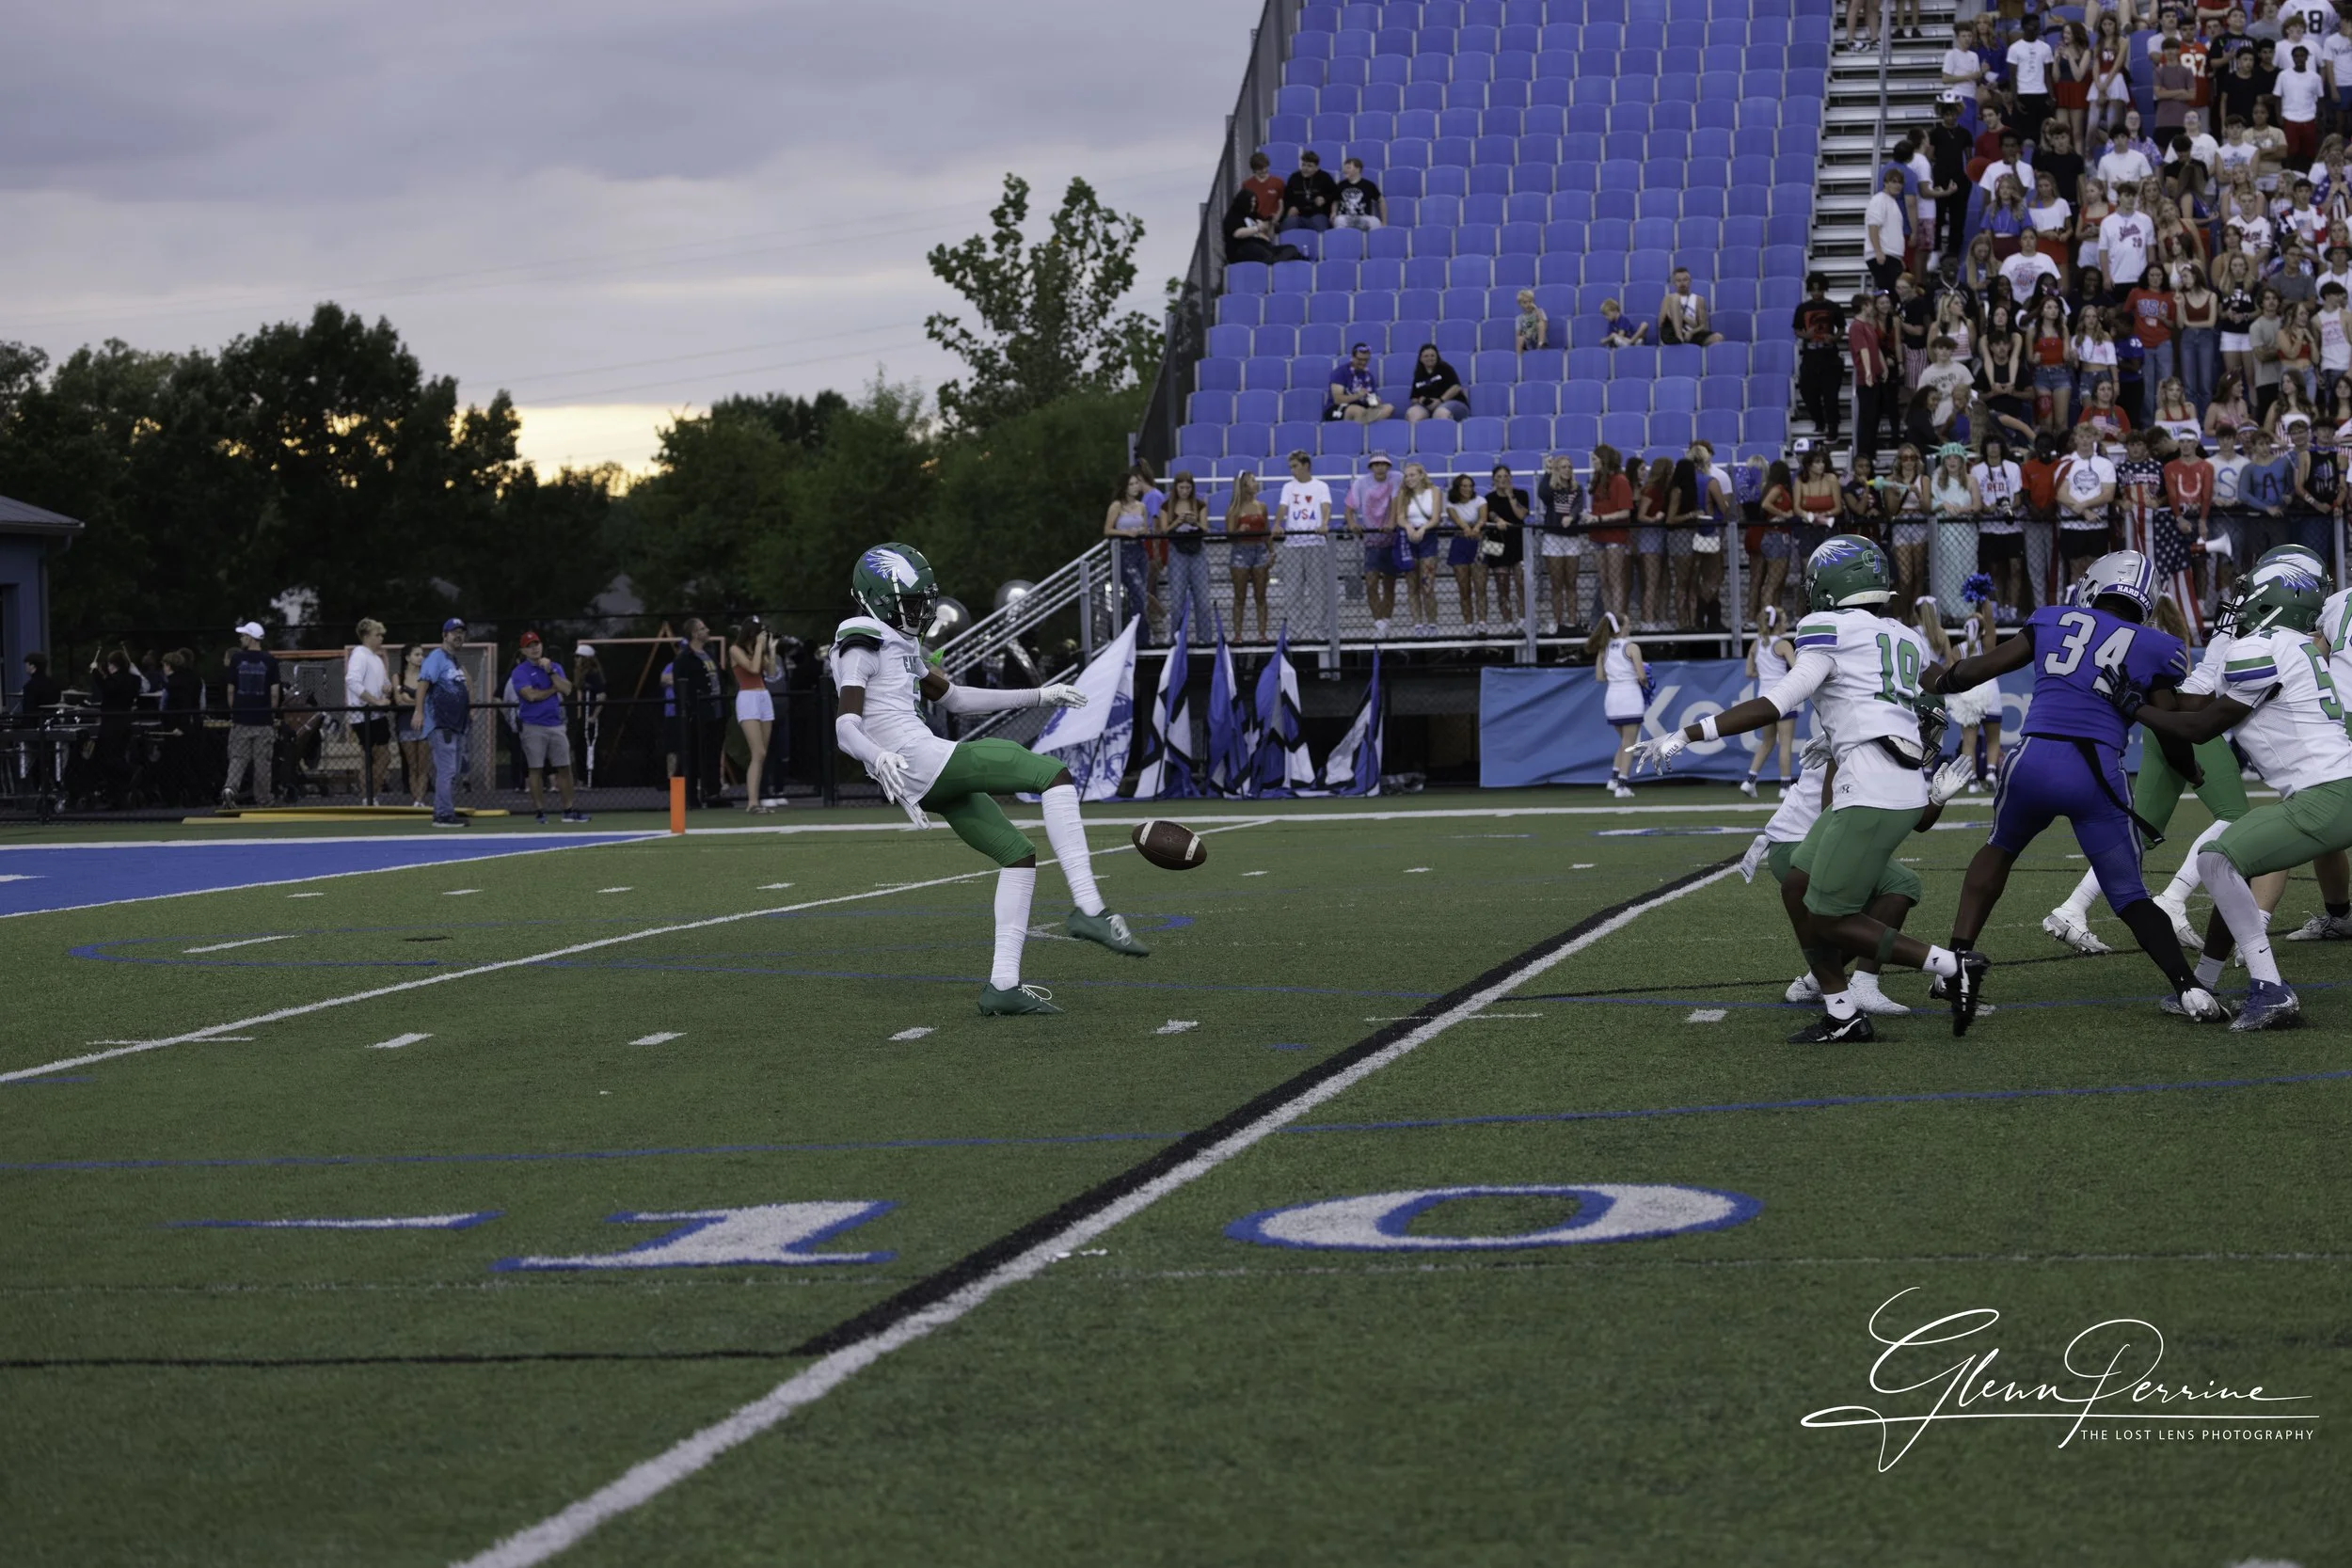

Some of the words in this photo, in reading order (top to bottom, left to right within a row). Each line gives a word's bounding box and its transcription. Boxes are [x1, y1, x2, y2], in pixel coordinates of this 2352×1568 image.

[1293, 494, 1300, 504] I
[1293, 508, 1316, 521] USA
[2117, 584, 2139, 598] HARD
[2139, 594, 2153, 610] WAY
[1874, 633, 1920, 711] 19
[2043, 610, 2137, 695] 34
[1225, 1182, 1765, 1253] 0
